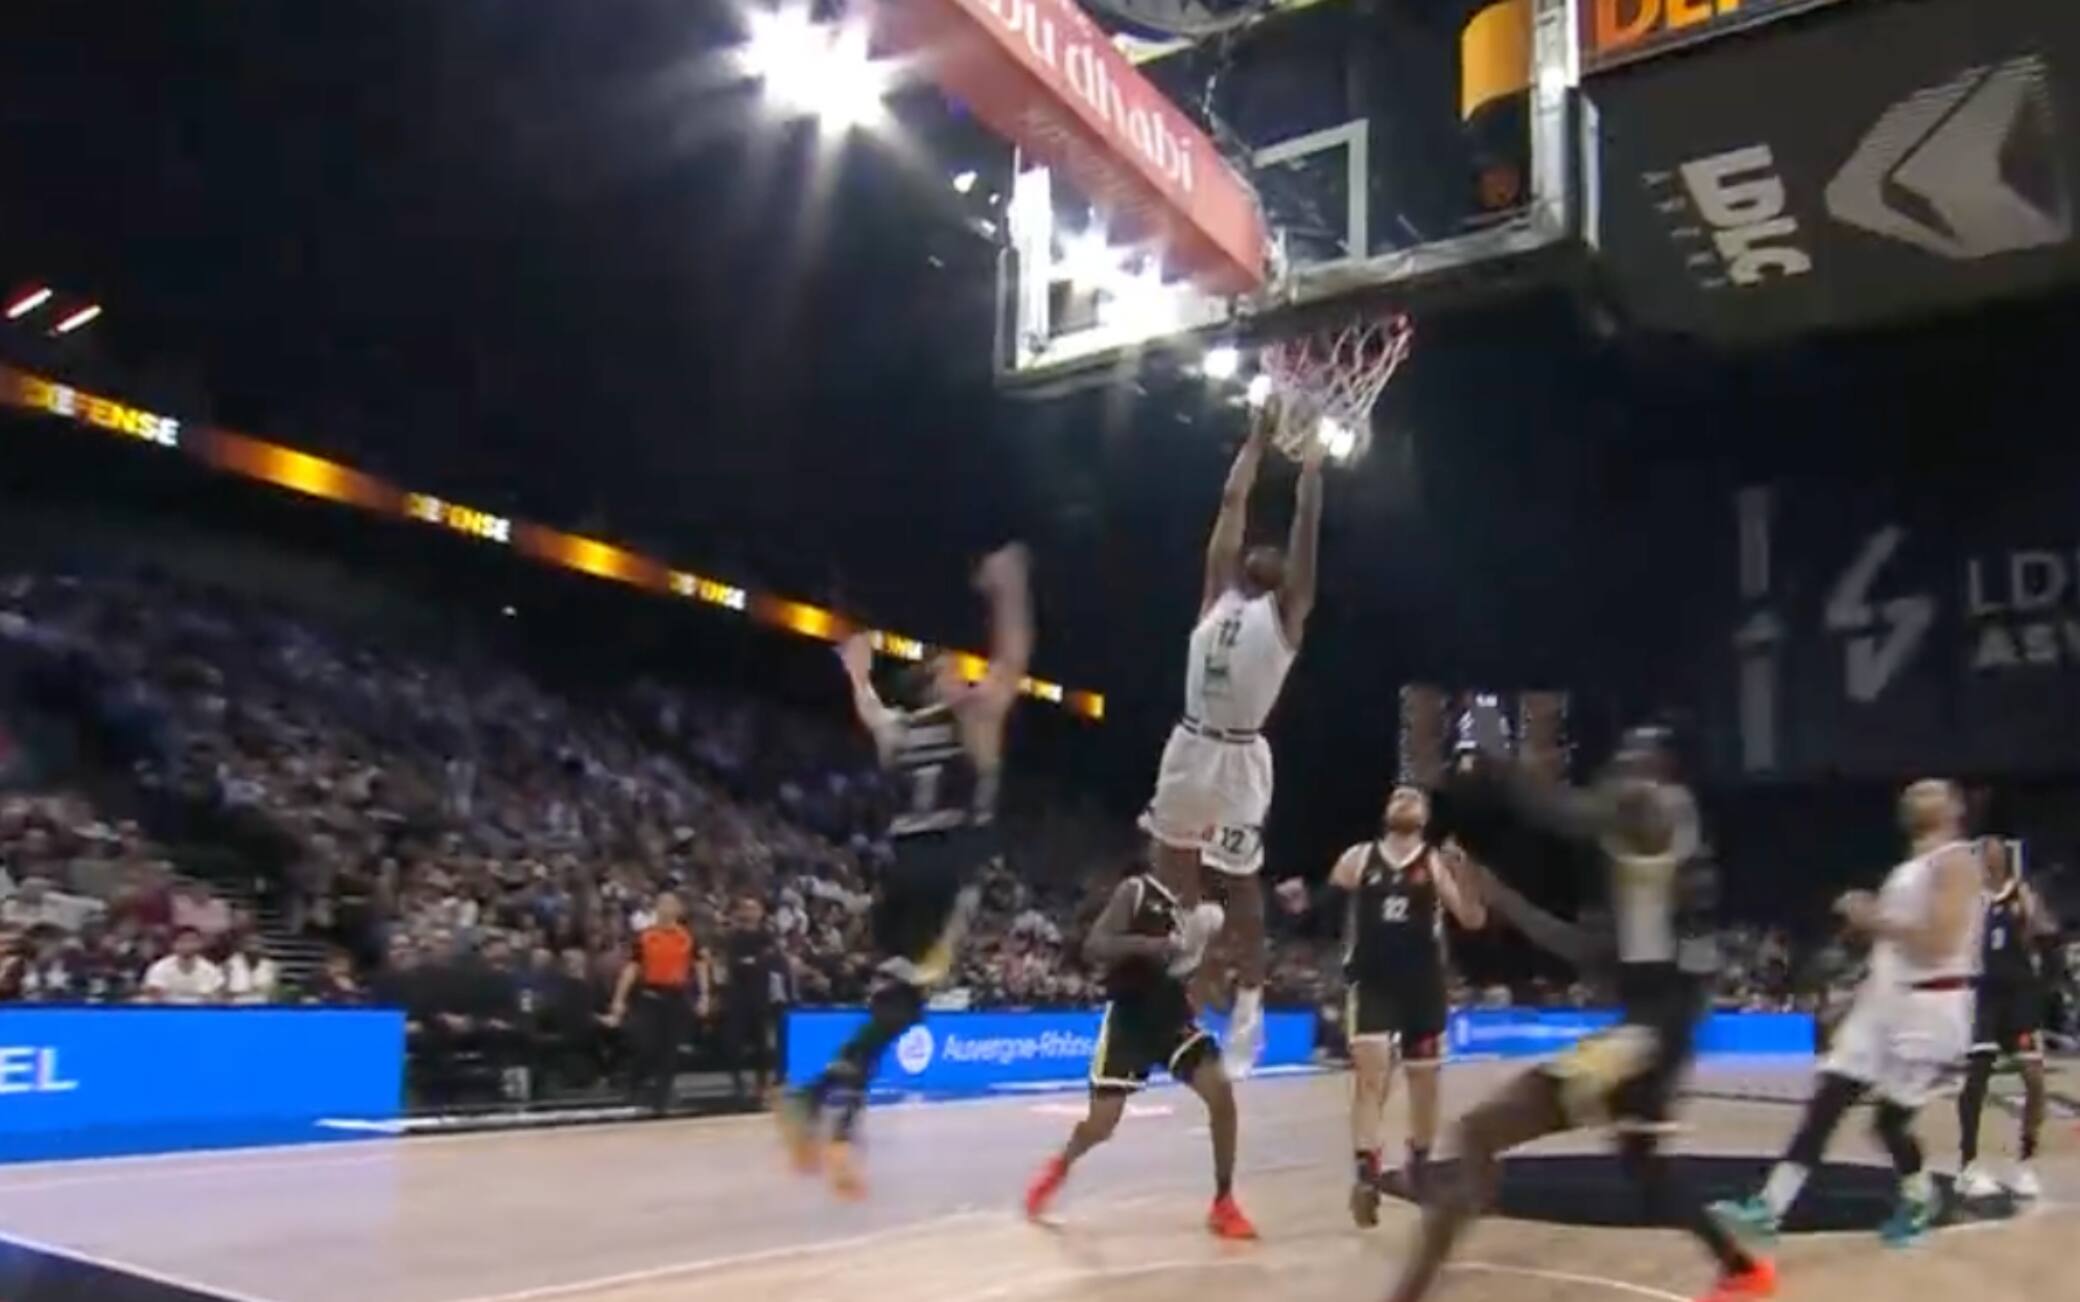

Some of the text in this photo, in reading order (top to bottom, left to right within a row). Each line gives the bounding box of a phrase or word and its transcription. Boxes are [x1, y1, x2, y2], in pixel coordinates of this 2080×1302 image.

[1065, 42, 1192, 192] dhabi
[1967, 550, 2080, 618] LD
[1221, 826, 1245, 855] 12
